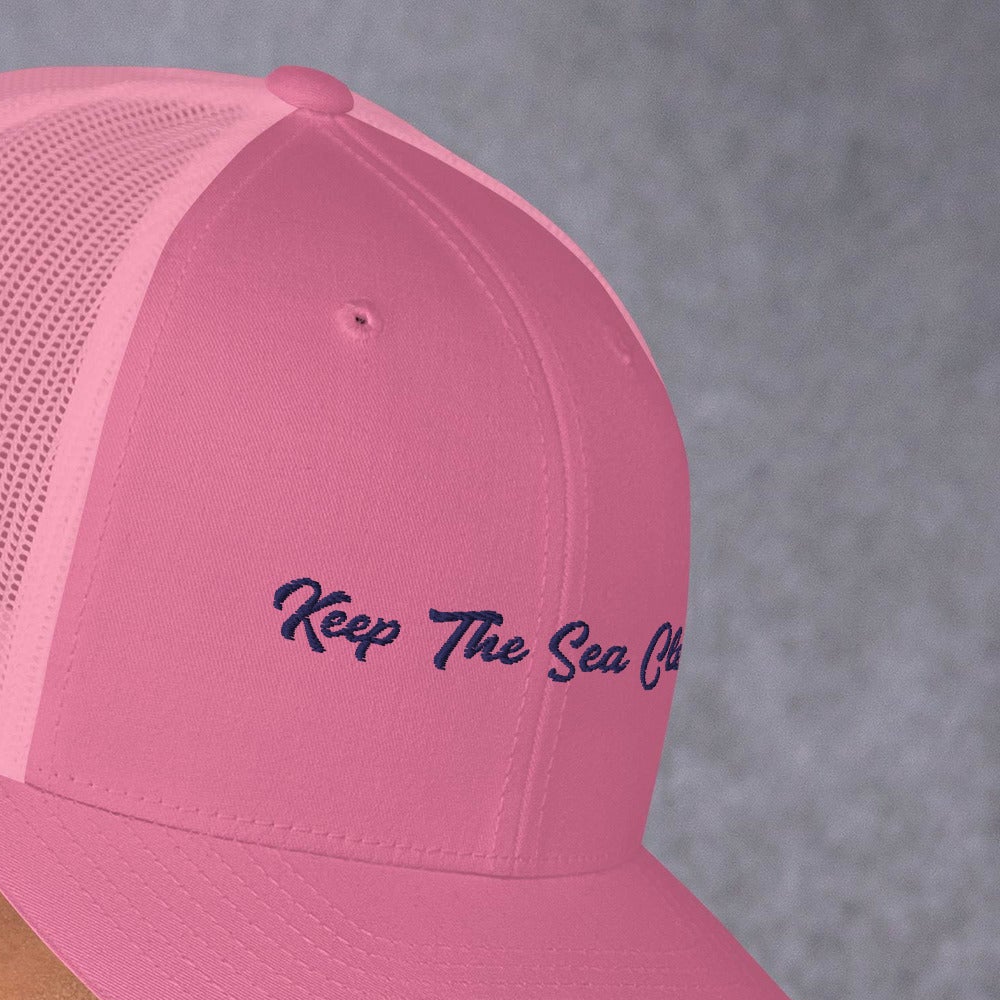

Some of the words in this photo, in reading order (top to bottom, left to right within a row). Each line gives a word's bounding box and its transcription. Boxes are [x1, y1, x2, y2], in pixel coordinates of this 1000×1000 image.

[273, 577, 402, 662] Keep
[428, 607, 531, 671] The
[547, 620, 631, 683] Sea
